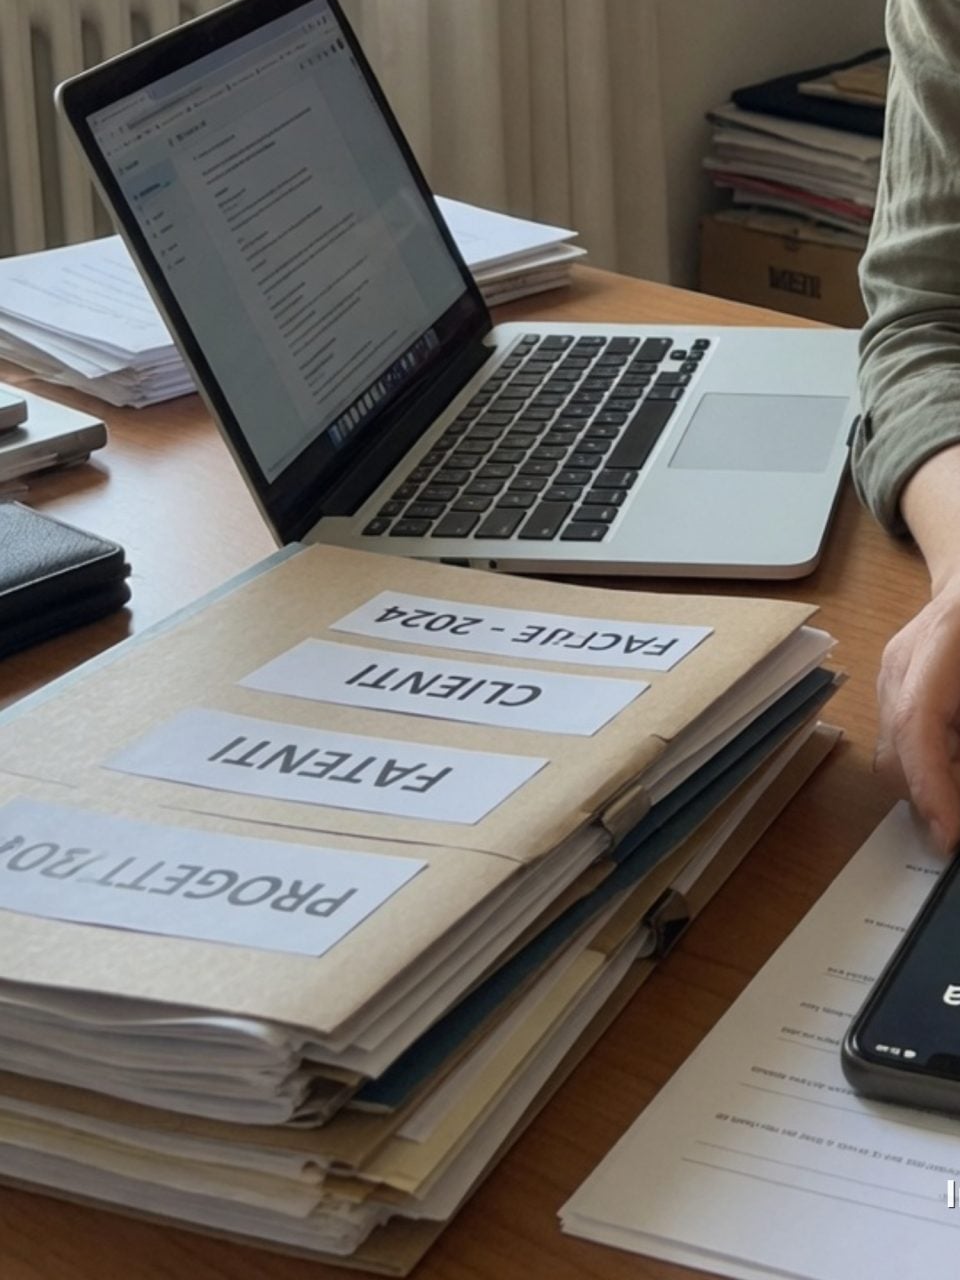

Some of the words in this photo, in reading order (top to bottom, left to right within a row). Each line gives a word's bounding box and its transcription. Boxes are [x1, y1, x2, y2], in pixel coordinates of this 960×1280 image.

[374, 606, 483, 636] 2024
[345, 663, 543, 708] CLIENTI
[207, 736, 454, 794] FATENTI
